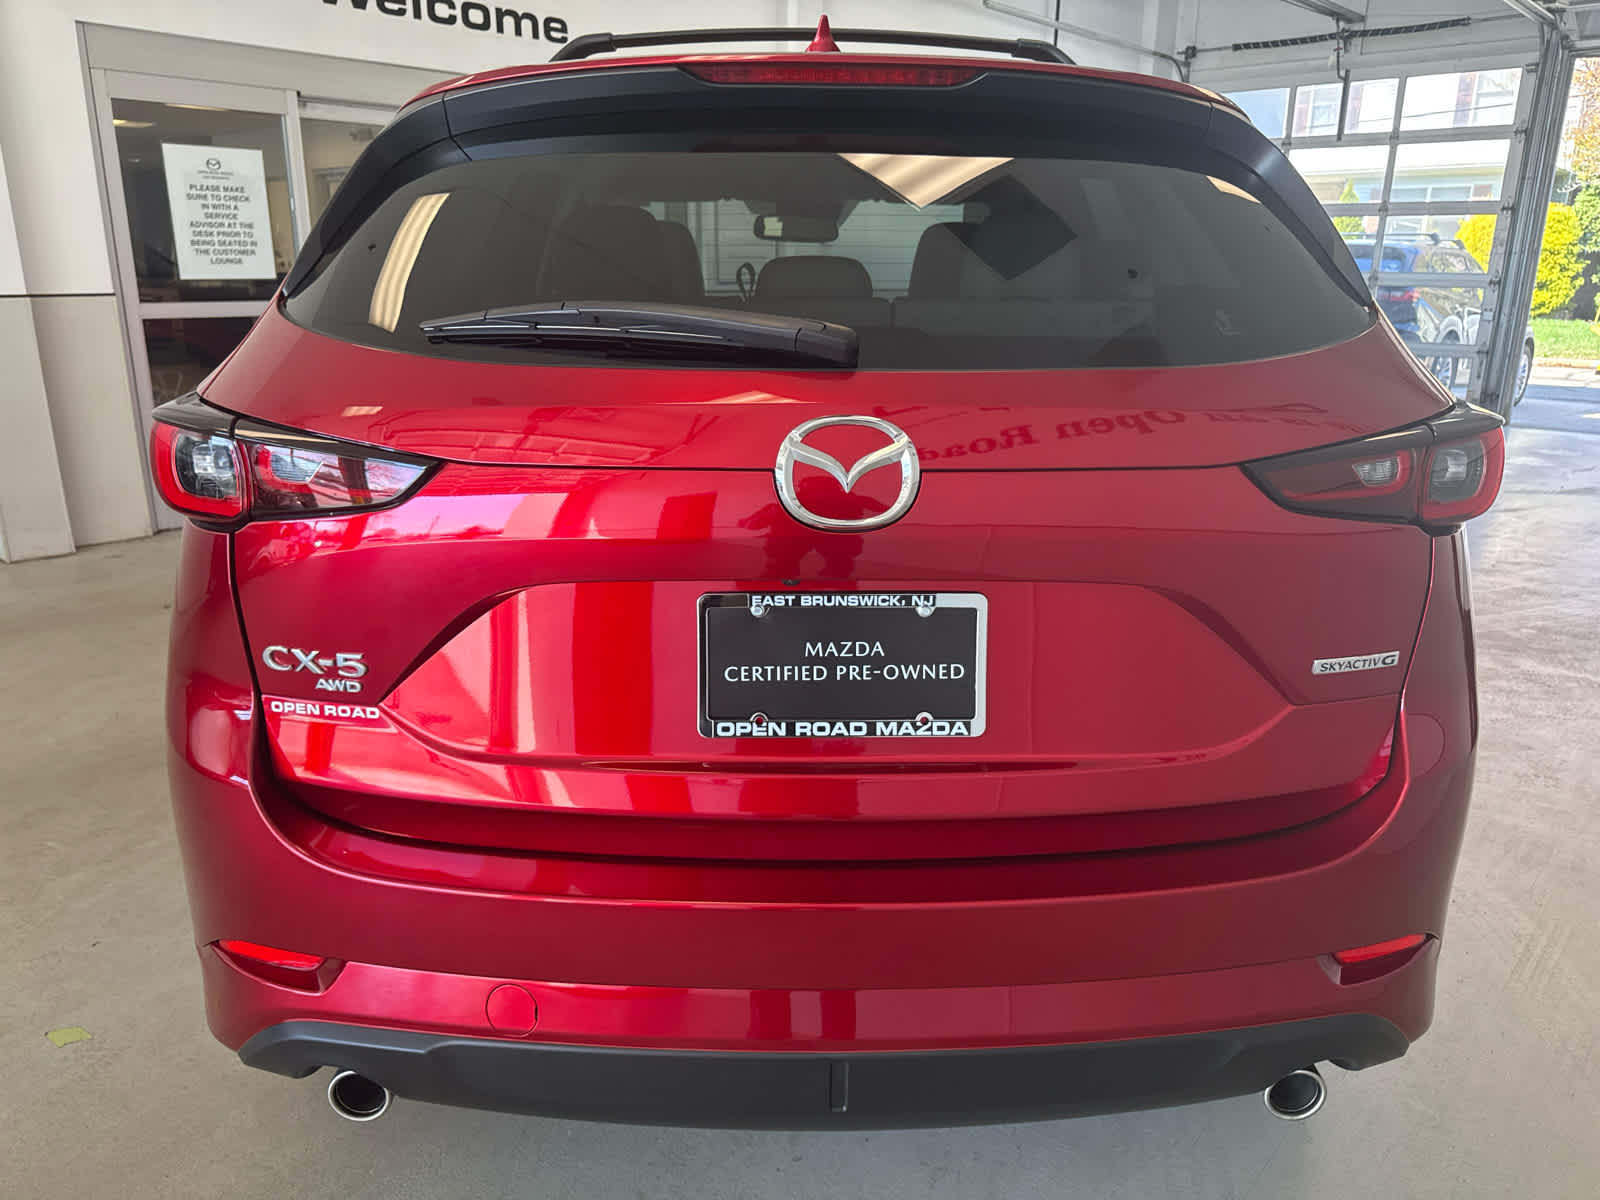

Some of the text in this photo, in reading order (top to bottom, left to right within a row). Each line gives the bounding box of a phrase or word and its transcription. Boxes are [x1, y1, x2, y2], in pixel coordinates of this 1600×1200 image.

[322, 0, 568, 44] elcome
[189, 184, 220, 192] PLEASE
[186, 193, 208, 201] SURE
[223, 194, 250, 202] CHECK
[211, 203, 231, 211] WITH
[204, 212, 238, 220] SERVICE
[190, 221, 225, 229] ADVISOR
[239, 222, 254, 230] THE
[192, 230, 215, 238] DESK
[243, 231, 254, 239] TO
[190, 239, 216, 247] BEING
[195, 248, 256, 256] THE CUSTOMER
[210, 257, 243, 265] LOUNGE
[751, 595, 934, 606] EAST BRUNSWICK, NJ
[804, 641, 885, 657] MAZDA
[262, 645, 369, 678] CX-5
[724, 663, 965, 682] CERTIFIED PRE-OWNED
[315, 678, 362, 693] AWD
[271, 701, 380, 719] OPEN ROAD
[716, 721, 969, 737] OPEN ROAD MAZDA
